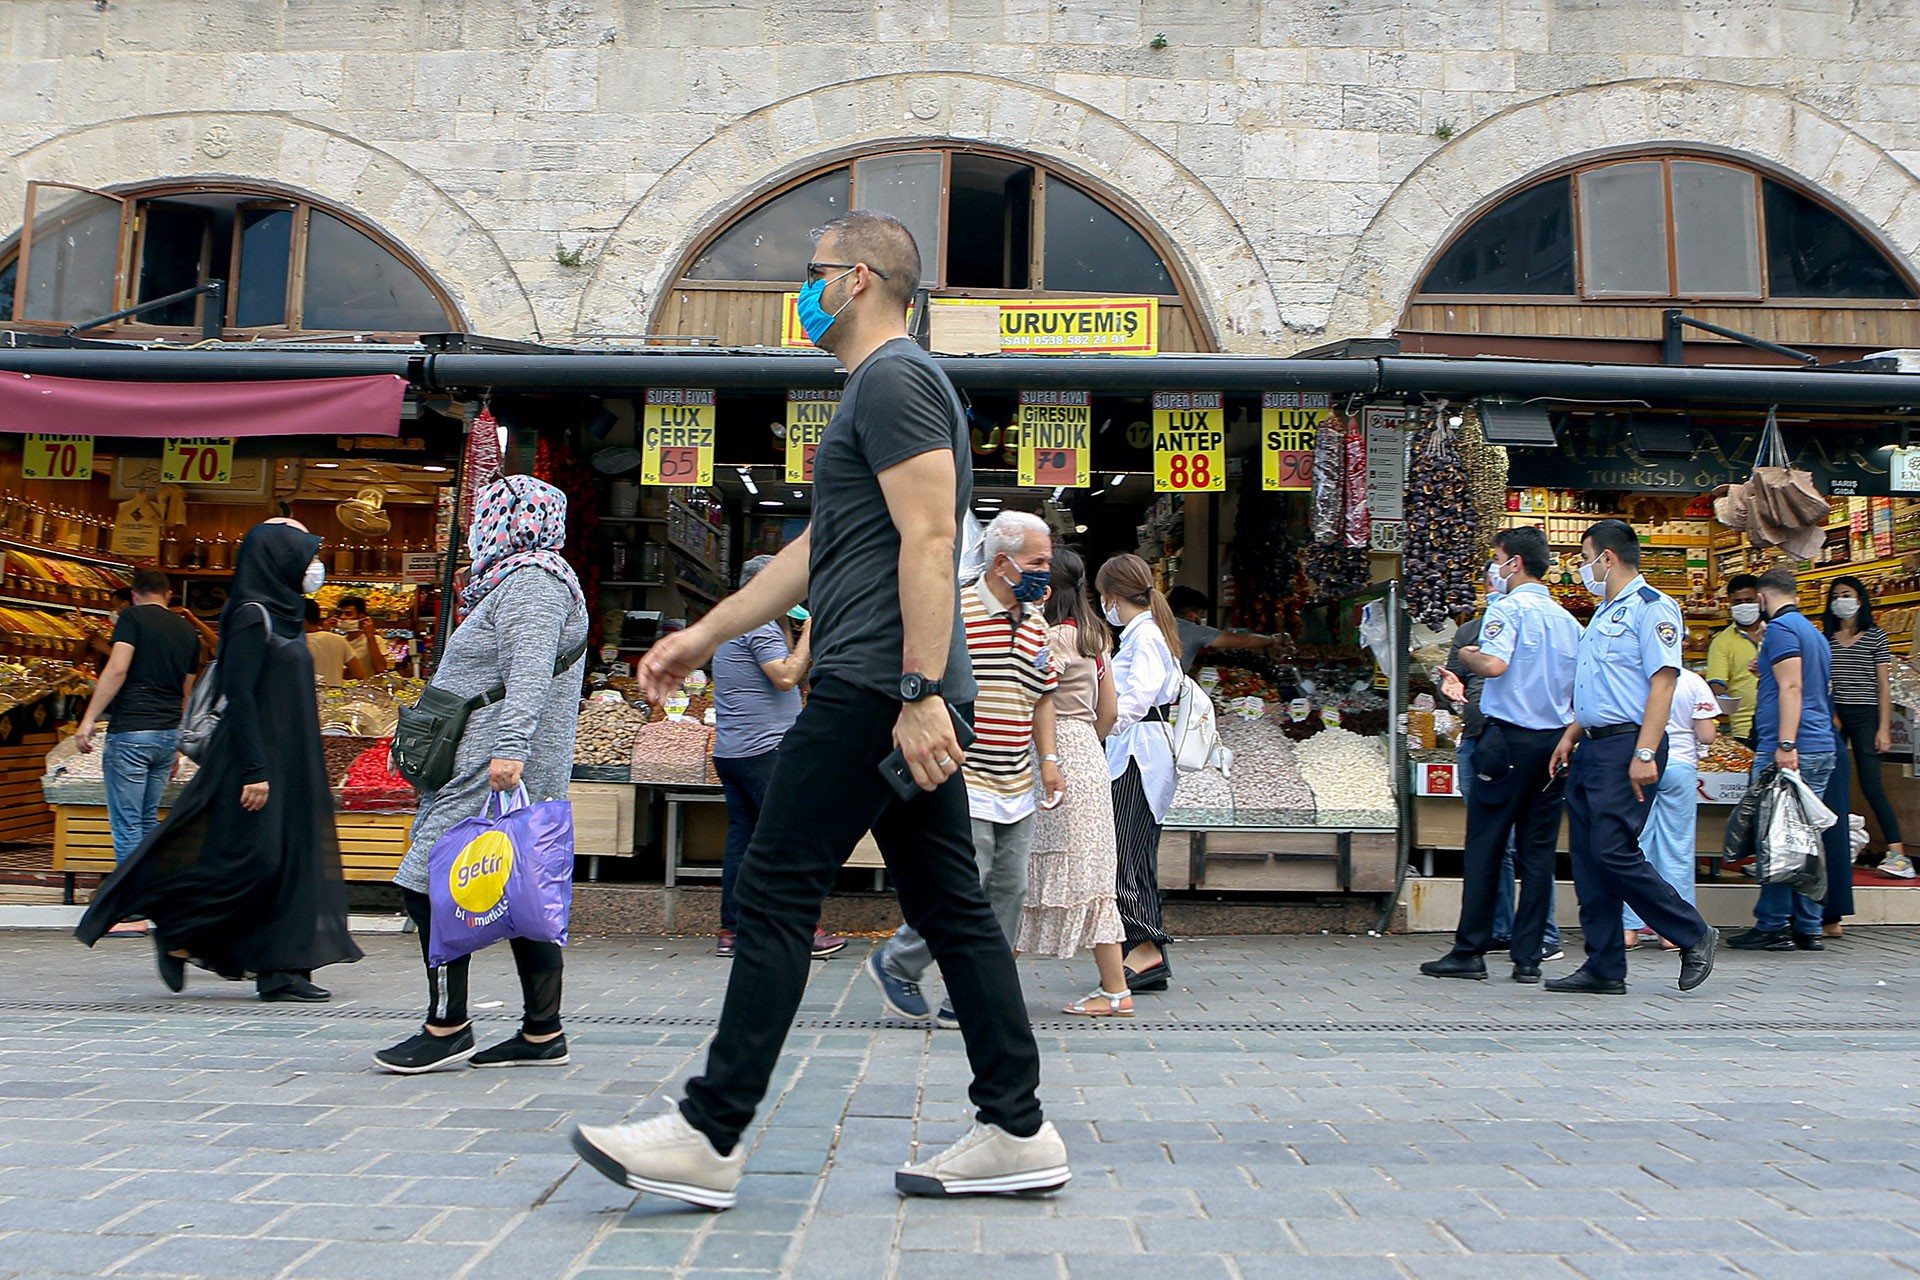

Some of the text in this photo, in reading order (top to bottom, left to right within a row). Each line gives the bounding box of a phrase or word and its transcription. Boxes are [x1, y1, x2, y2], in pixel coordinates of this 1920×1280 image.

[1000, 311, 1138, 338] URUYEMiŞ
[1034, 335, 1064, 346] 0538
[1067, 334, 1089, 345] 582
[1093, 333, 1107, 344] 21
[1111, 332, 1126, 344] 91
[1024, 407, 1086, 423] GiRESUN
[646, 427, 713, 451] ÇEREZ
[1022, 423, 1086, 448] FINDIK
[1129, 426, 1150, 443] 17
[1155, 432, 1222, 451] ANTEP
[1267, 431, 1317, 450] SiiR
[44, 443, 77, 477] 70
[178, 447, 219, 481] 70
[661, 450, 693, 477] 65
[1037, 451, 1066, 469] 70
[1170, 453, 1211, 489] 88
[1281, 454, 1314, 482] 90
[457, 853, 503, 888] getir
